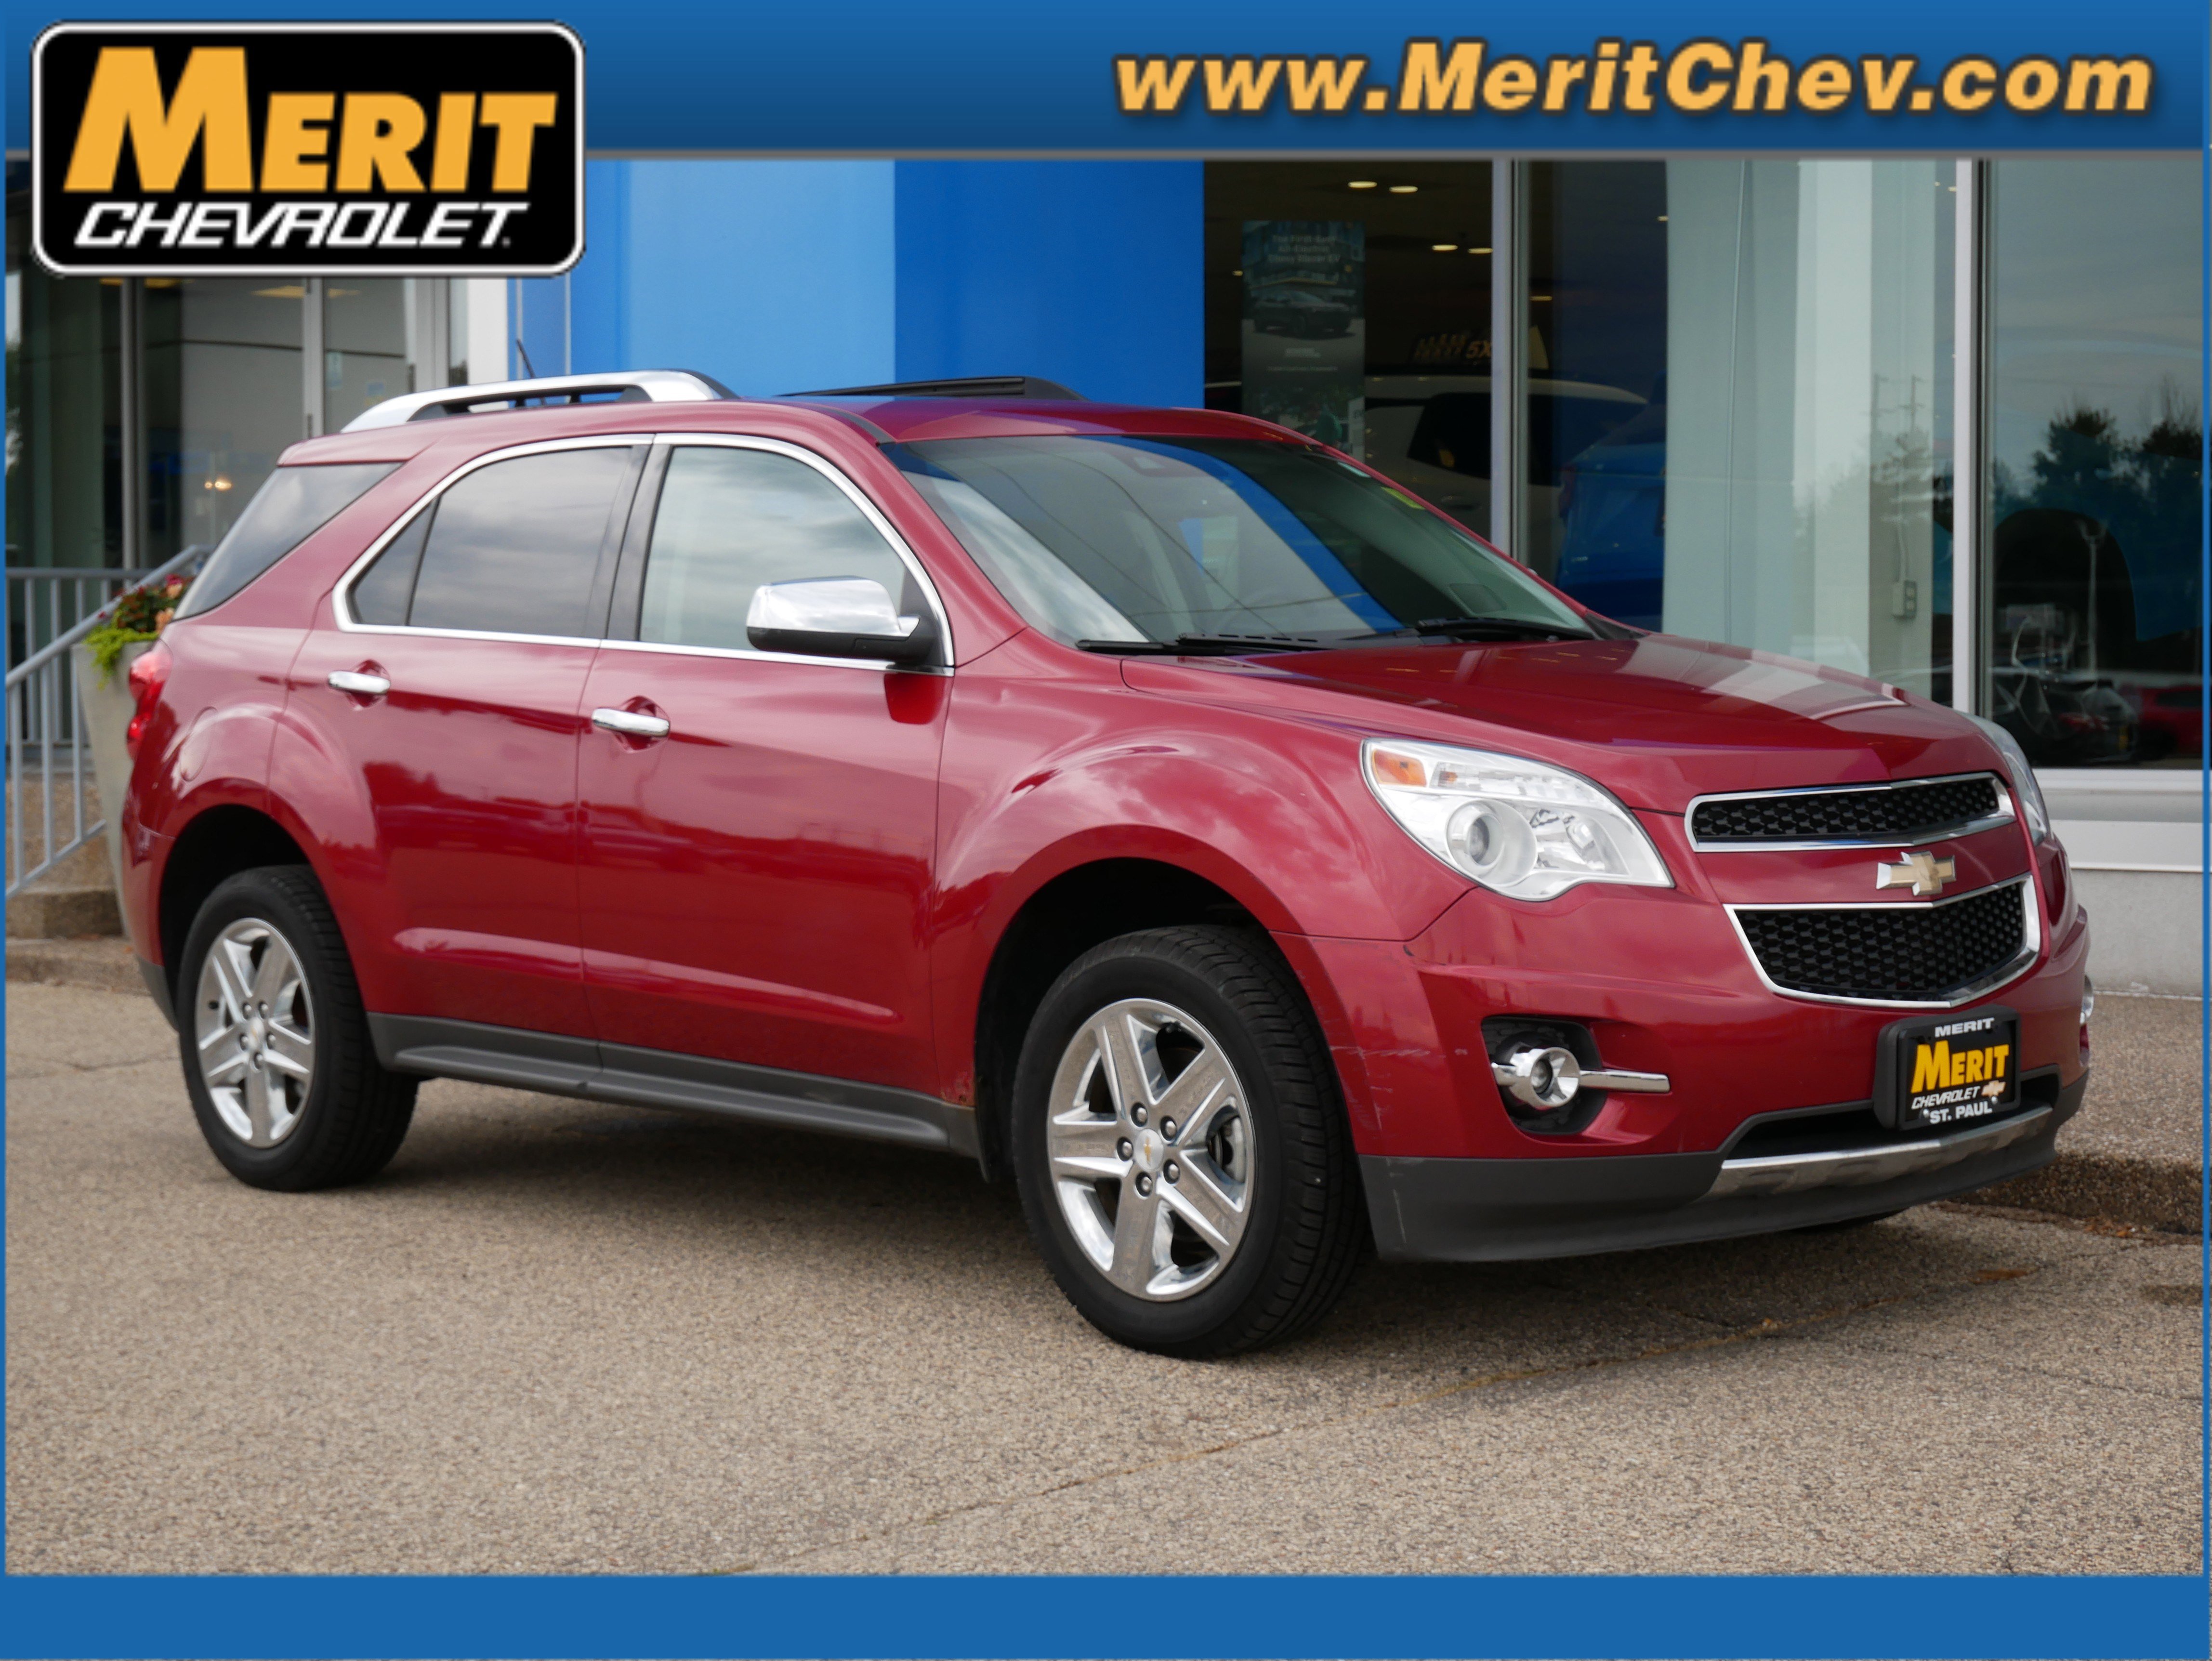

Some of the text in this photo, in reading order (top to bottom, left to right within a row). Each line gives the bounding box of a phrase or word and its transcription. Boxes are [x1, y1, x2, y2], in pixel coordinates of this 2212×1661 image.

[1935, 1017, 1995, 1038] MERIT
[1911, 1085, 1981, 1110] CHEVROLET
[1929, 1101, 1993, 1124] ST. PAUL
